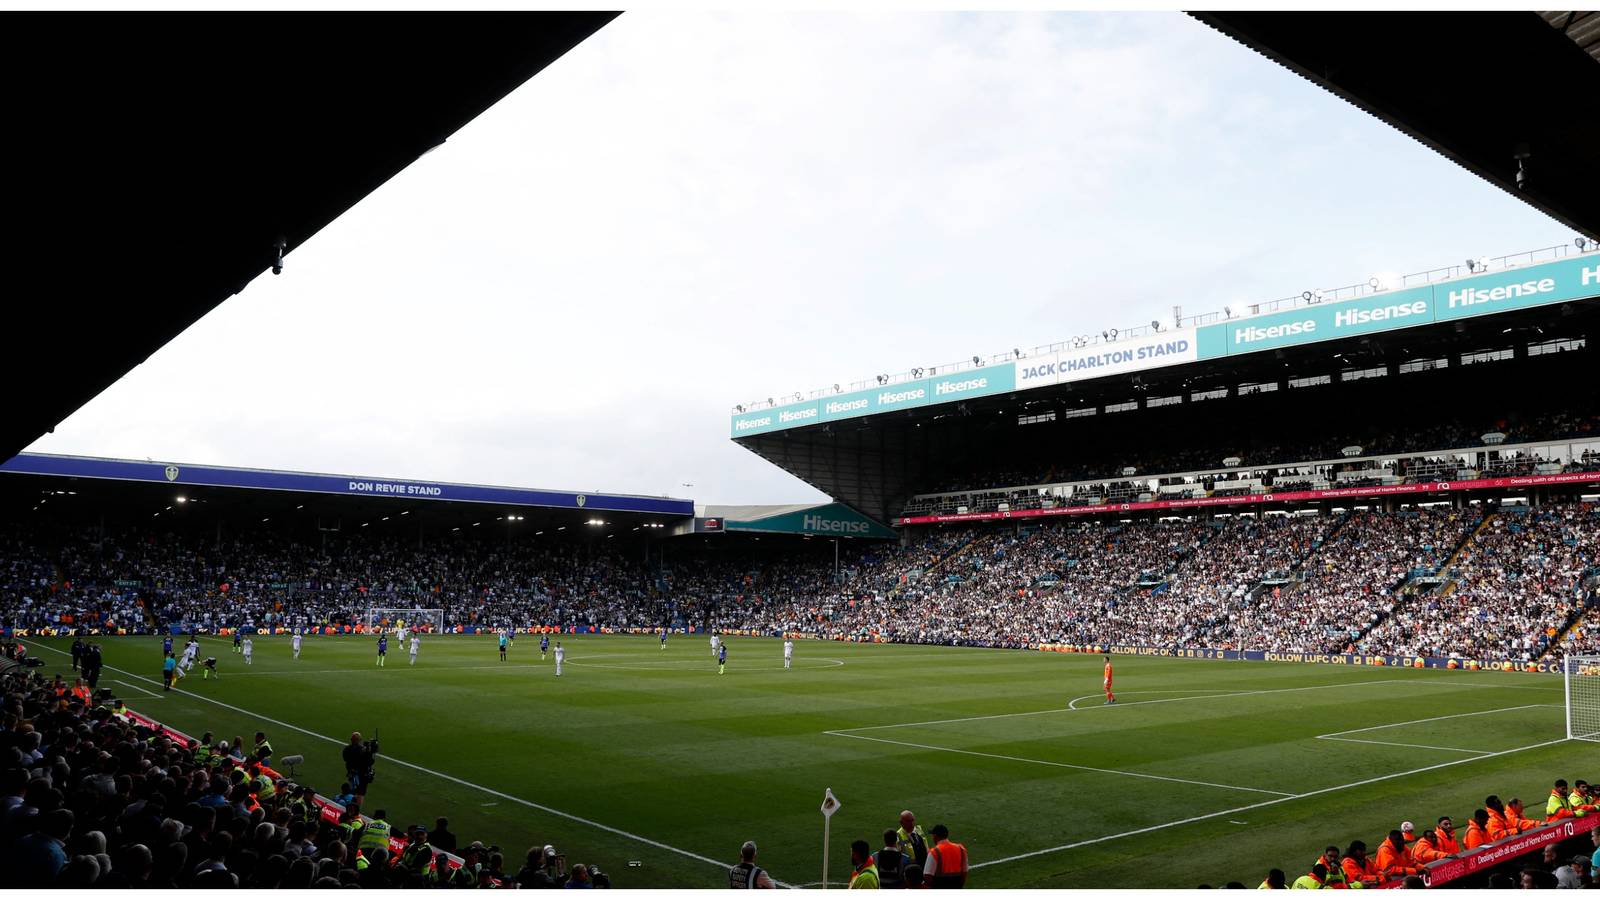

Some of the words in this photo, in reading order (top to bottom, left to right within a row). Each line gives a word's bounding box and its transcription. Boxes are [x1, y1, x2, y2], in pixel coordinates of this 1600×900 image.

[1449, 275, 1555, 308] Hisense
[1335, 300, 1426, 327] Hisense
[1235, 318, 1315, 344] Hisense
[1022, 363, 1056, 380] JACK
[1059, 349, 1133, 373] CHARLTON
[1137, 340, 1188, 360] STAND
[936, 377, 987, 395] Hisense
[878, 386, 925, 405] Hisense
[779, 407, 817, 423] Hisense
[825, 398, 868, 414] Hisense
[735, 415, 771, 431] Hisense
[349, 481, 373, 491] DON
[376, 483, 406, 494] REVIE
[408, 486, 441, 496] STAND
[803, 514, 870, 533] Hisense
[1110, 646, 1137, 655] OLLOW
[1138, 647, 1159, 656] LUFC
[1264, 652, 1302, 663] FOLLOW
[1304, 654, 1329, 664] LUFC
[1331, 655, 1347, 665] ON
[1463, 660, 1506, 671] FLLO
[1514, 662, 1546, 673] LUC
[1477, 852, 1494, 865] Dealing
[1494, 848, 1504, 859] with
[1510, 842, 1524, 854] aspects
[1541, 831, 1555, 841] Finance
[1431, 860, 1465, 882] mortgages
